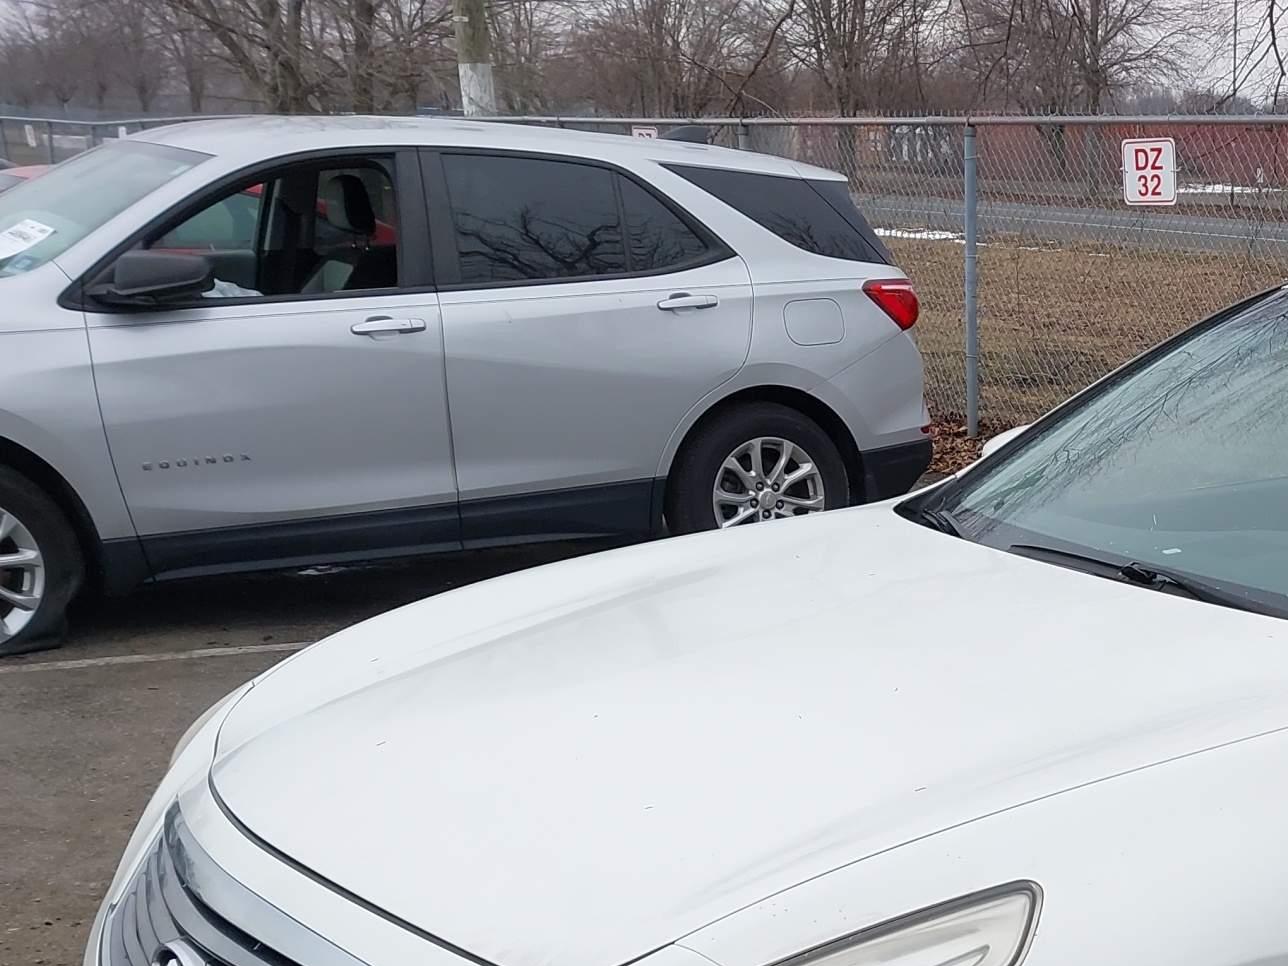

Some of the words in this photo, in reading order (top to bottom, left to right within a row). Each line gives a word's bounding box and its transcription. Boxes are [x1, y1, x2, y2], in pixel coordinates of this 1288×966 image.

[1134, 147, 1164, 171] DZ
[1137, 174, 1162, 197] 32
[142, 453, 251, 471] EQUINOX
